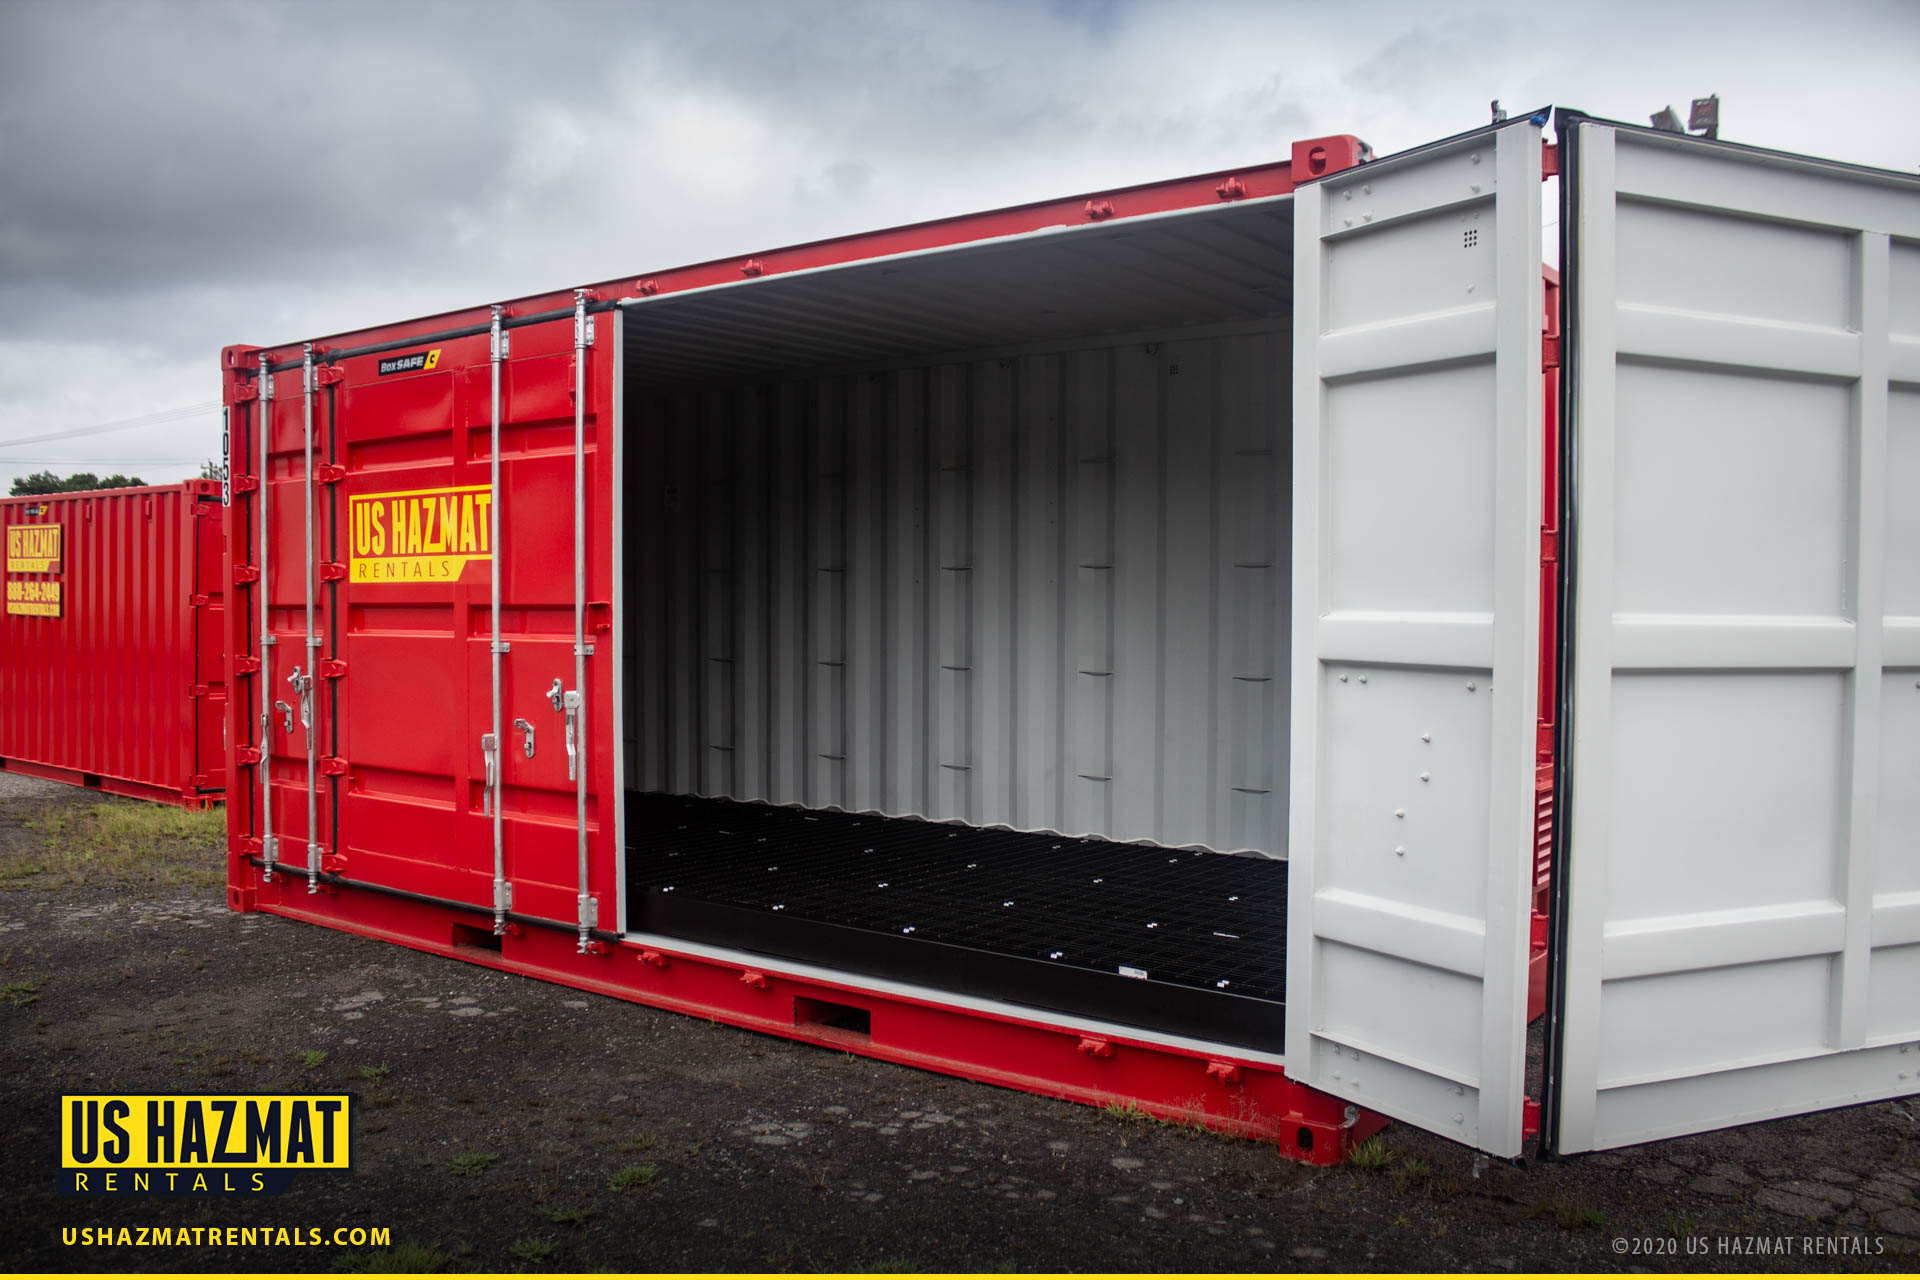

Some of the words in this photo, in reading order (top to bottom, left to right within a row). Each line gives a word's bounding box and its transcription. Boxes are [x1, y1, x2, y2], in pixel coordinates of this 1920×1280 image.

[356, 501, 386, 556] US
[391, 493, 492, 555] HAZMAT
[9, 530, 21, 557] US
[23, 529, 59, 557] HAZMAT
[358, 560, 450, 579] RENTALS
